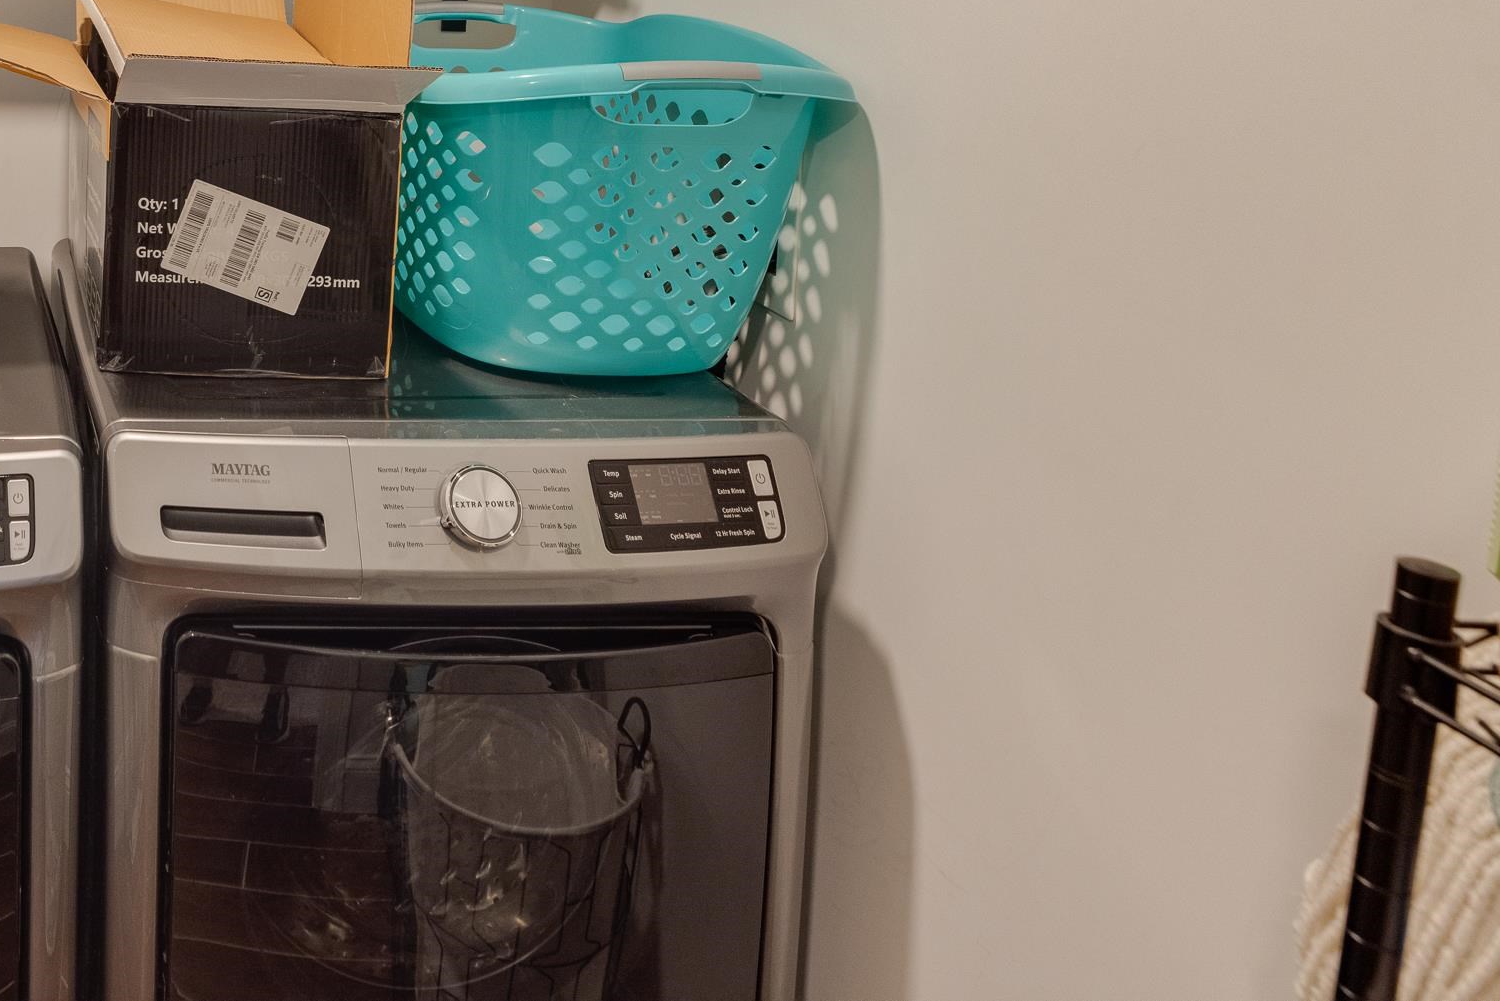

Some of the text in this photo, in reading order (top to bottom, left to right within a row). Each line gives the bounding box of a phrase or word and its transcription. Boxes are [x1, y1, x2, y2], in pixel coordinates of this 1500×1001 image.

[137, 197, 179, 213] Qty: 1
[136, 222, 163, 235] Net
[211, 463, 270, 476] MAYTAG
[377, 466, 428, 475] Normal Regular
[532, 467, 549, 475] Quick
[712, 468, 726, 476] Delay
[602, 470, 620, 478] Temp
[380, 485, 415, 493] Heavy Duty
[609, 491, 623, 499] Spin
[670, 532, 702, 541] Cycle Signal
[729, 529, 743, 537] Fresh
[743, 529, 756, 537] Spin
[388, 541, 405, 549] Bulky
